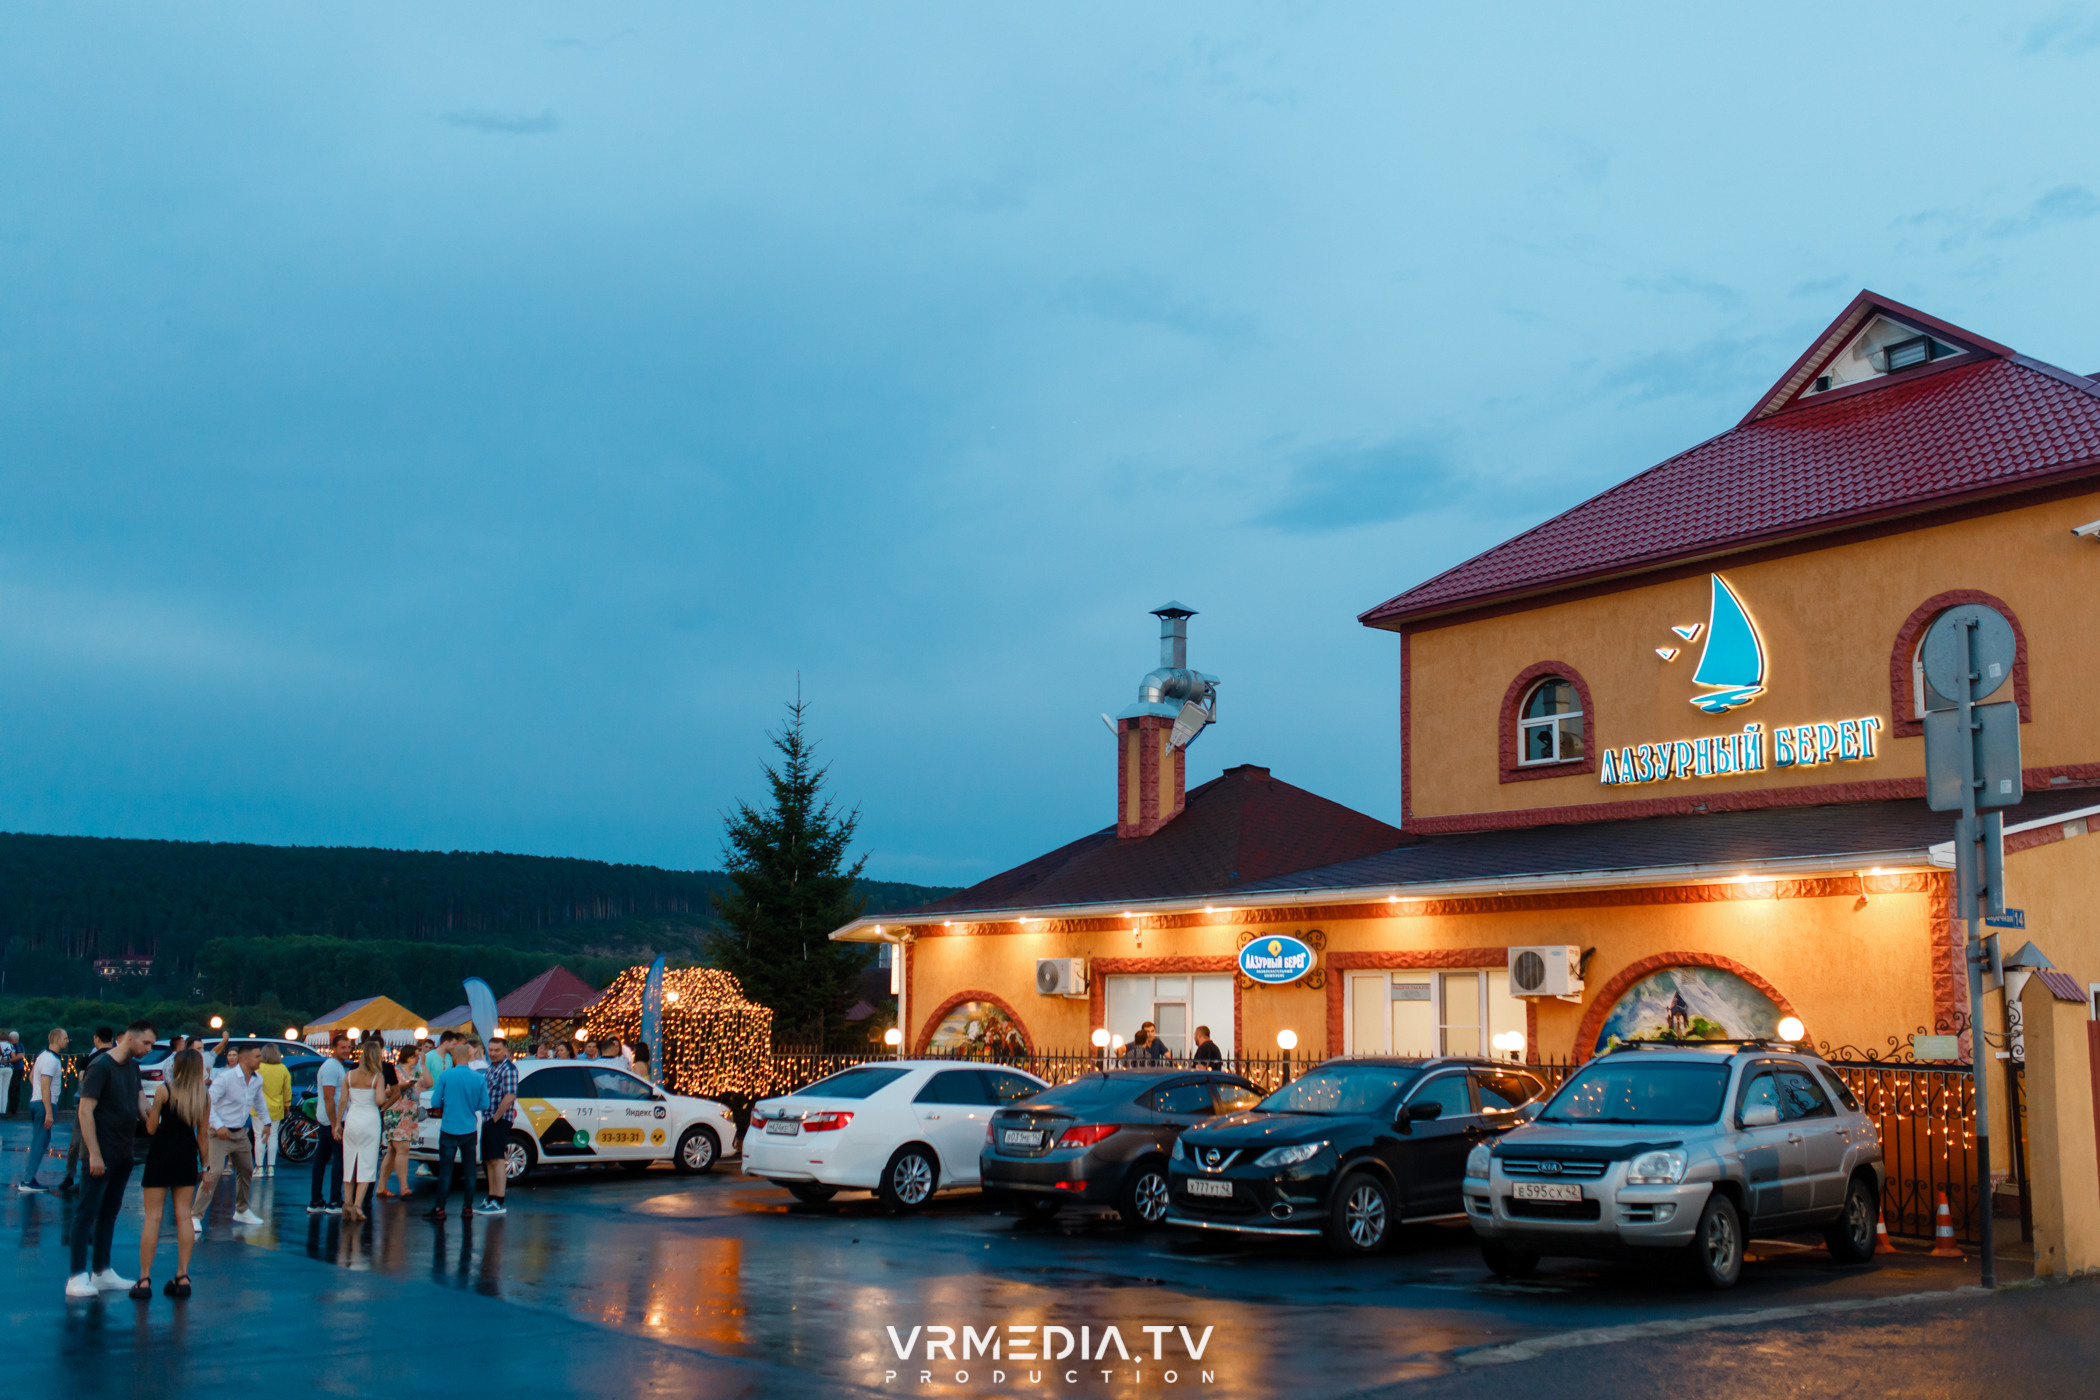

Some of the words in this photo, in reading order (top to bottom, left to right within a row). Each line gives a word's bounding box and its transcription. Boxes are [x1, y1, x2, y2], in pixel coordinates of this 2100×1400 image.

[1600, 723, 1763, 785] ЛАЗУРНЫЙ
[1774, 717, 1879, 767] БЕРЕГ
[2015, 911, 2024, 926] 14
[1245, 953, 1283, 969] ЛАЗУРНЫЙ
[1284, 952, 1307, 969] БЕРЕГ
[577, 1107, 593, 1116] 757
[625, 1107, 652, 1117] Яндекс
[655, 1109, 665, 1117] Go
[602, 1133, 639, 1142] 33-33-31
[1541, 1163, 1558, 1171] KIA
